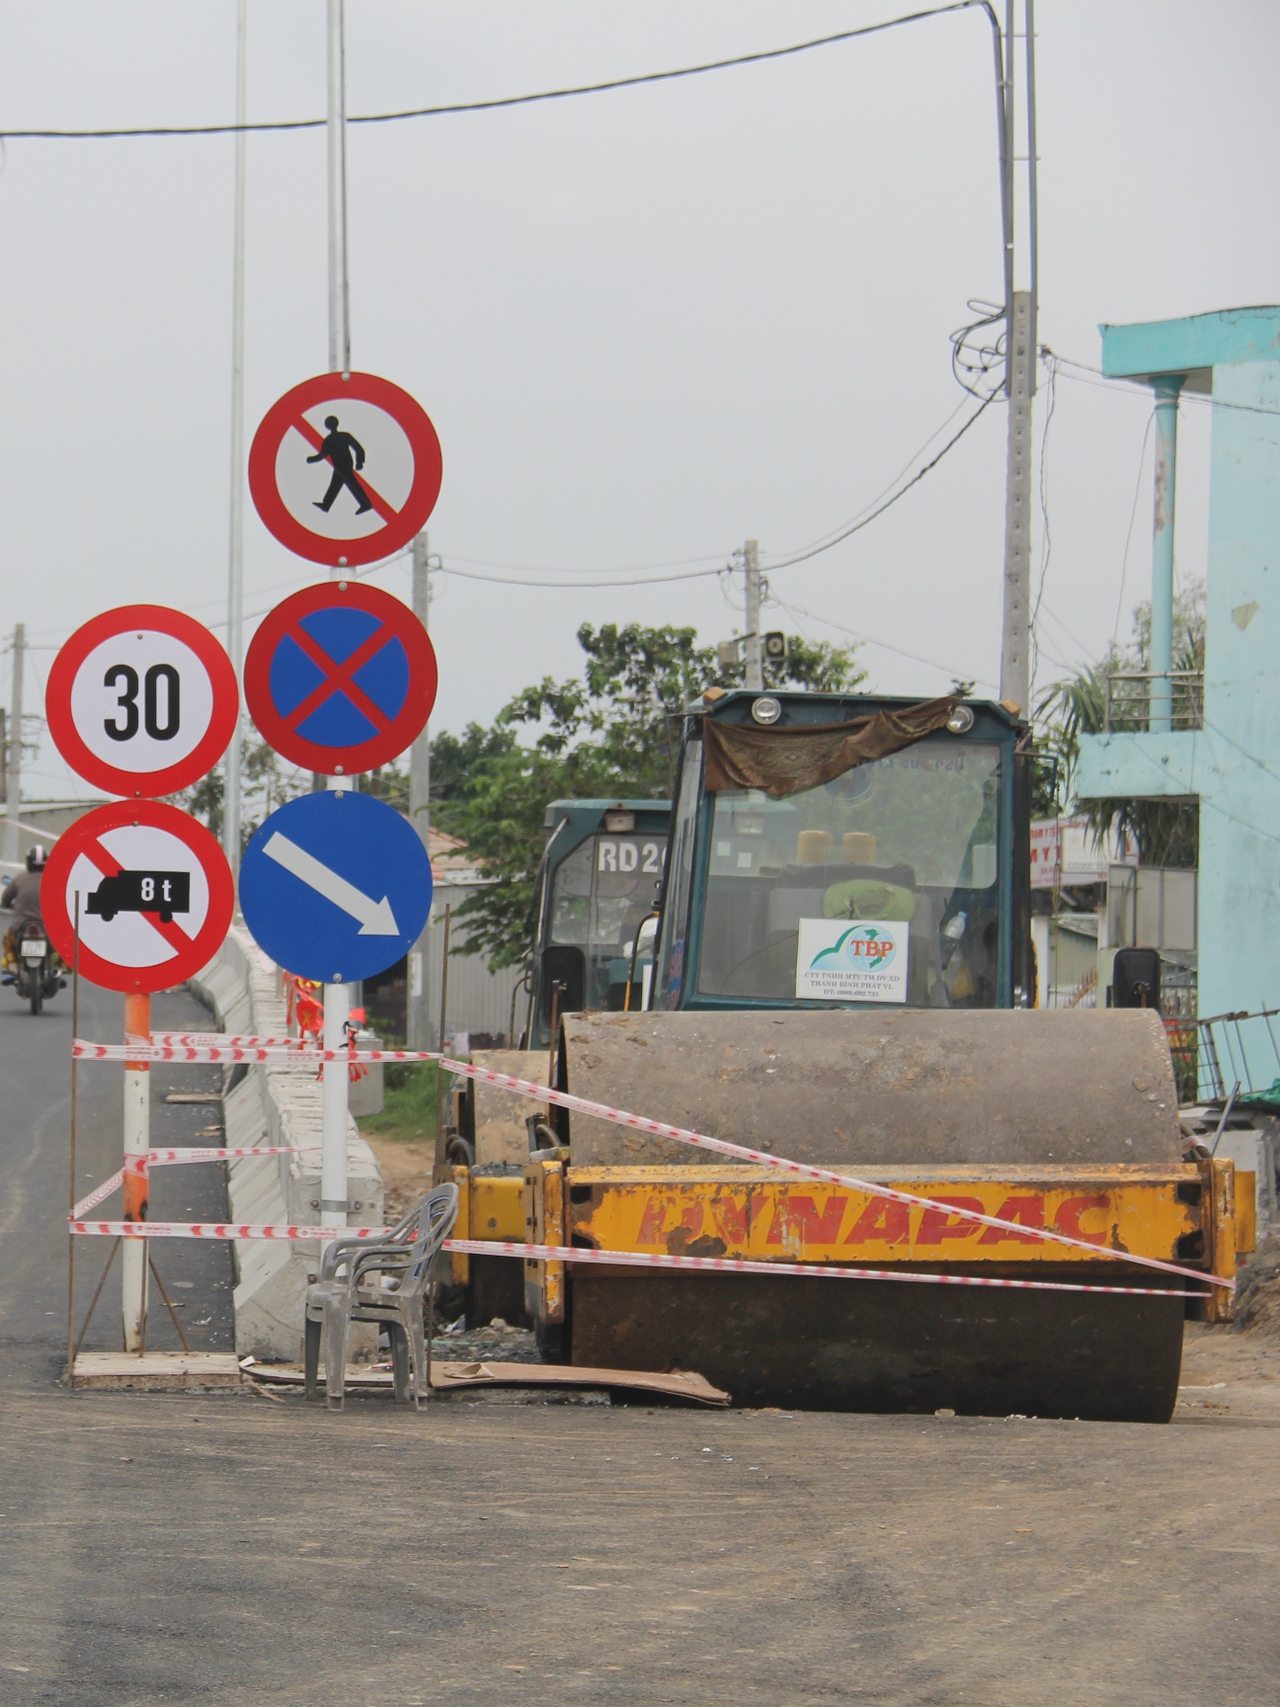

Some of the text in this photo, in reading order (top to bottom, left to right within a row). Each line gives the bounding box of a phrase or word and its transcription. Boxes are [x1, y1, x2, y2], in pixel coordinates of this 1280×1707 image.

[104, 663, 180, 742] 30
[141, 877, 172, 902] 8 t
[850, 940, 894, 957] TBP
[636, 1195, 1112, 1246] DYNAPAC
